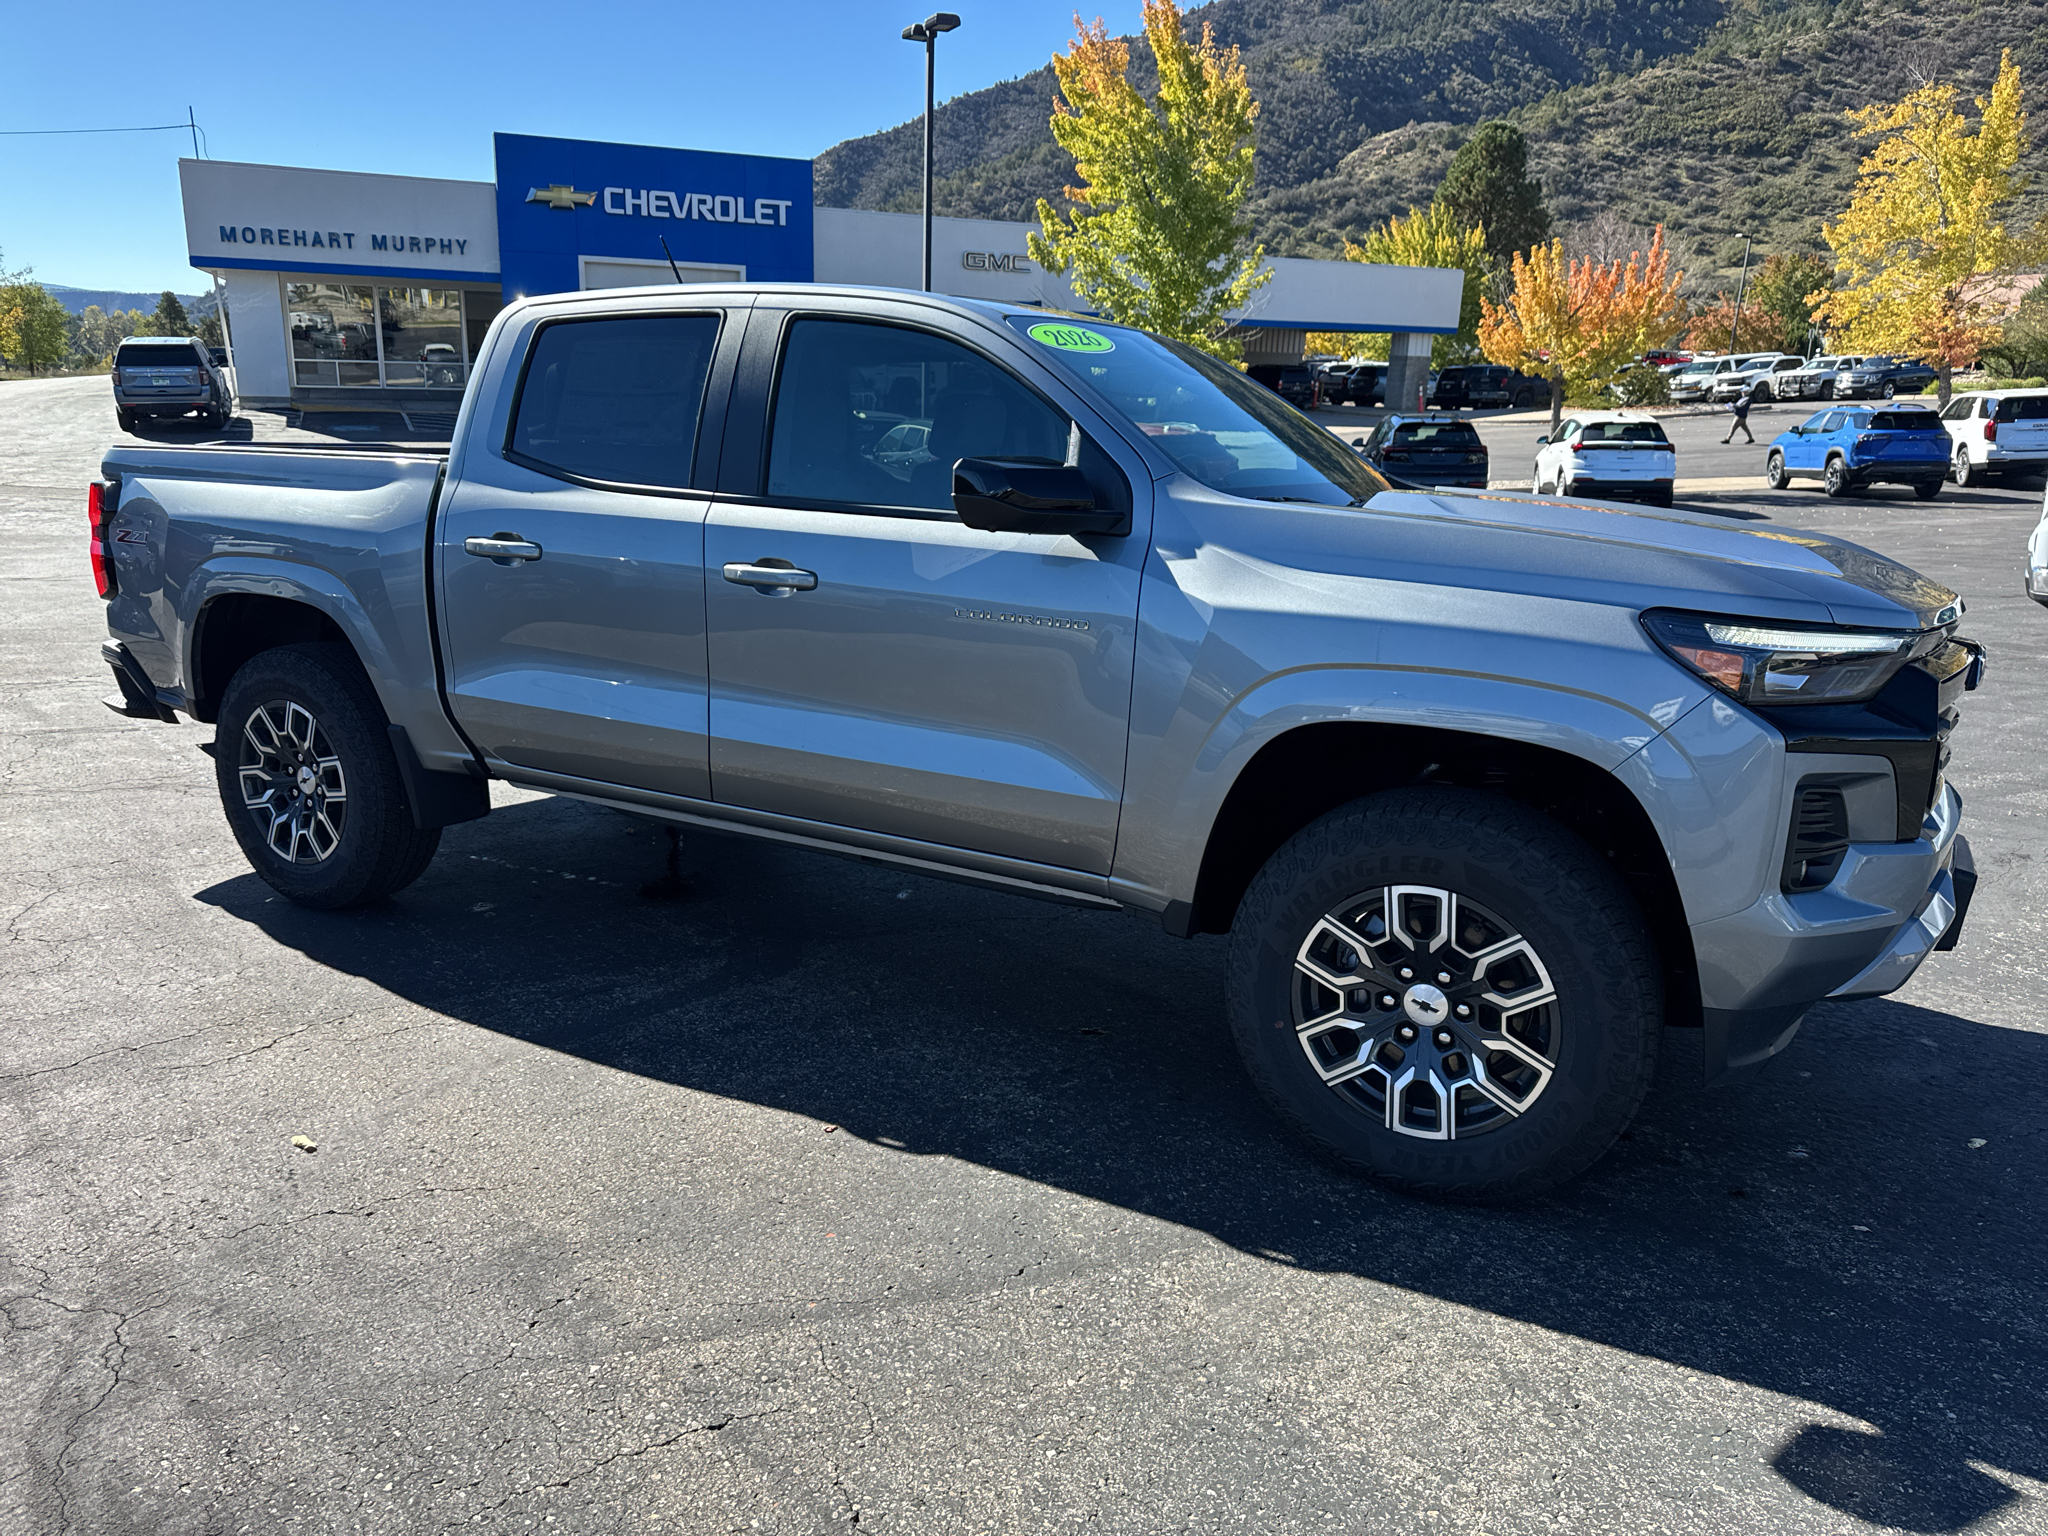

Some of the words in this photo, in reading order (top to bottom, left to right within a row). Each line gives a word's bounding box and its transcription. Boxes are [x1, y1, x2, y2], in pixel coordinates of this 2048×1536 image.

[603, 186, 793, 226] CHEVROLET
[219, 225, 356, 250] MOREHART
[371, 233, 468, 256] MURPHY
[963, 252, 1031, 272] GMC
[1044, 329, 1102, 348] 2026
[115, 528, 149, 546] Z71
[954, 607, 1090, 631] COLORADO
[1274, 855, 1445, 934] WRANGLER
